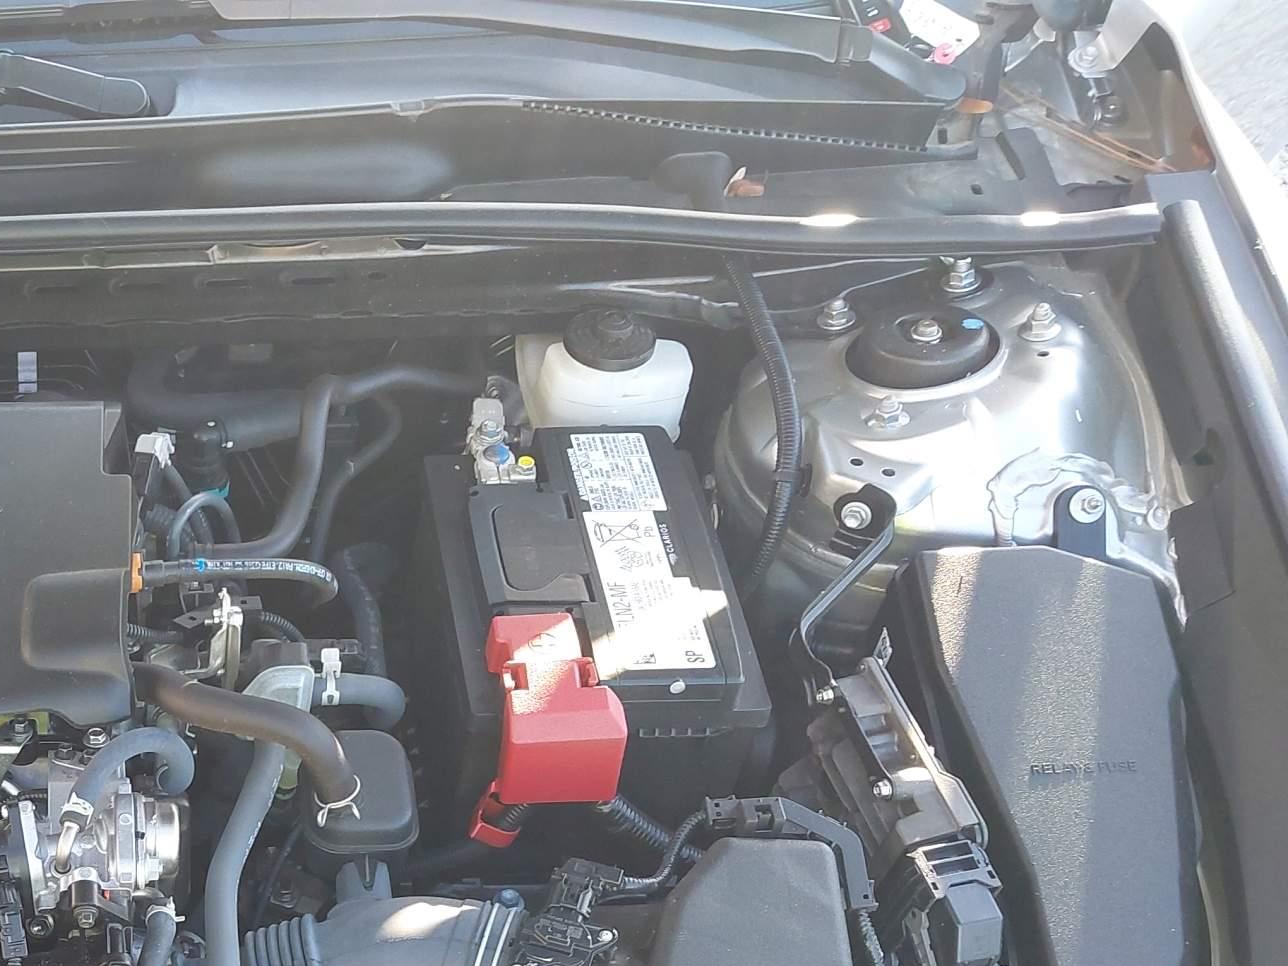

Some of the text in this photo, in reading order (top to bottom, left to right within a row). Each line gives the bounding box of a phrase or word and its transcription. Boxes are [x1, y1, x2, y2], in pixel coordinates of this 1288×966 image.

[659, 523, 675, 553] CLARIOS
[685, 650, 705, 663] SP
[1030, 761, 1082, 775] RELAY
[1096, 760, 1137, 773] FUSE
